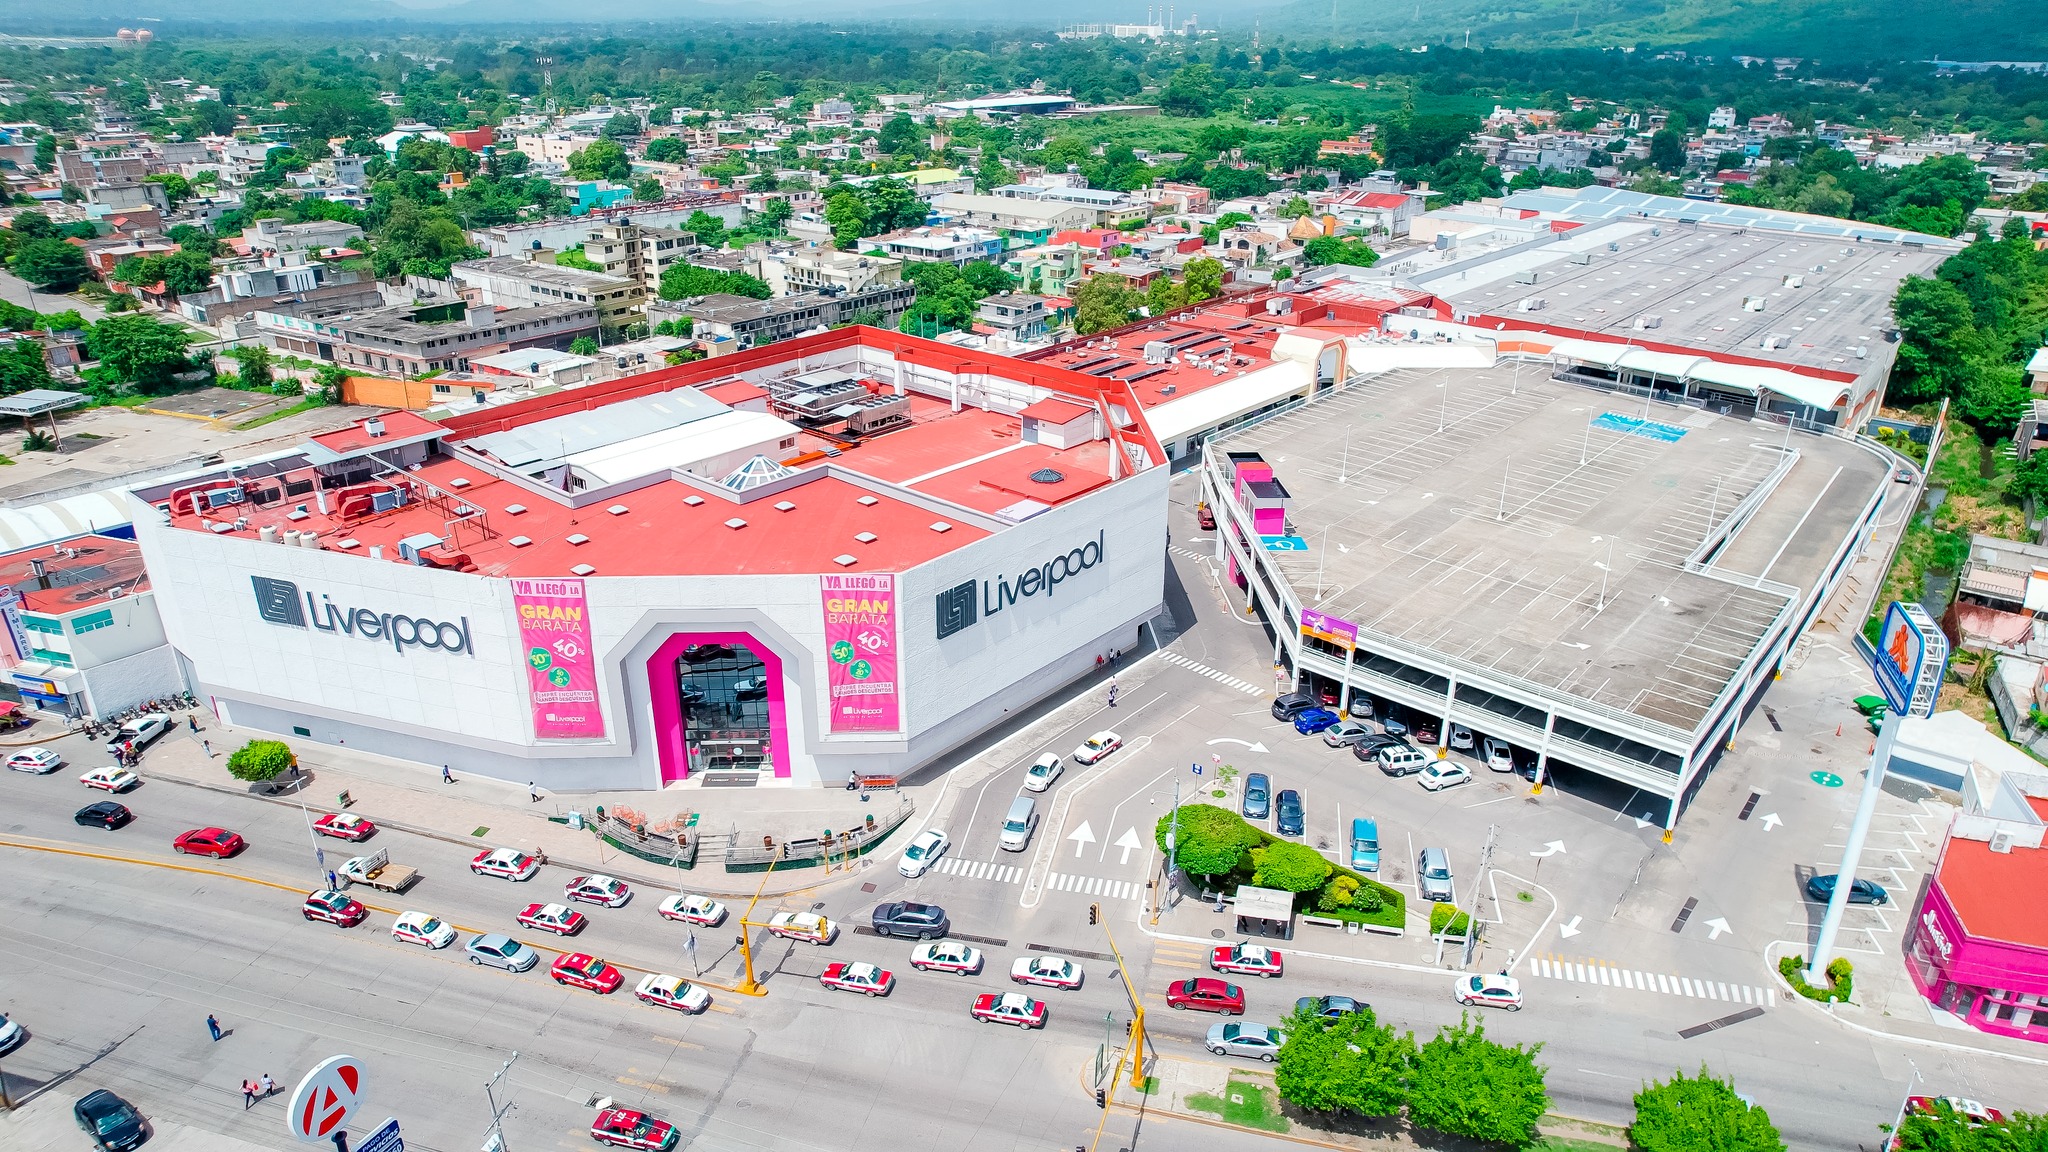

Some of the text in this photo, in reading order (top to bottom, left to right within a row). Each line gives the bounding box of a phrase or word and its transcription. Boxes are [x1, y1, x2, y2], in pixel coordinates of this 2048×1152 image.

[984, 529, 1104, 617] Liverpool
[516, 581, 579, 595] YA LLEGÓ LA
[826, 576, 888, 589] YA LLEGÓ LA
[520, 604, 582, 621] GRAN
[826, 598, 888, 614] GRAN
[306, 591, 472, 655] Liverpool
[522, 619, 582, 632] BARATA
[828, 613, 888, 625] BARATA
[552, 639, 585, 657] 40%
[857, 631, 889, 650] 40%
[381, 1128, 391, 1138] DE
